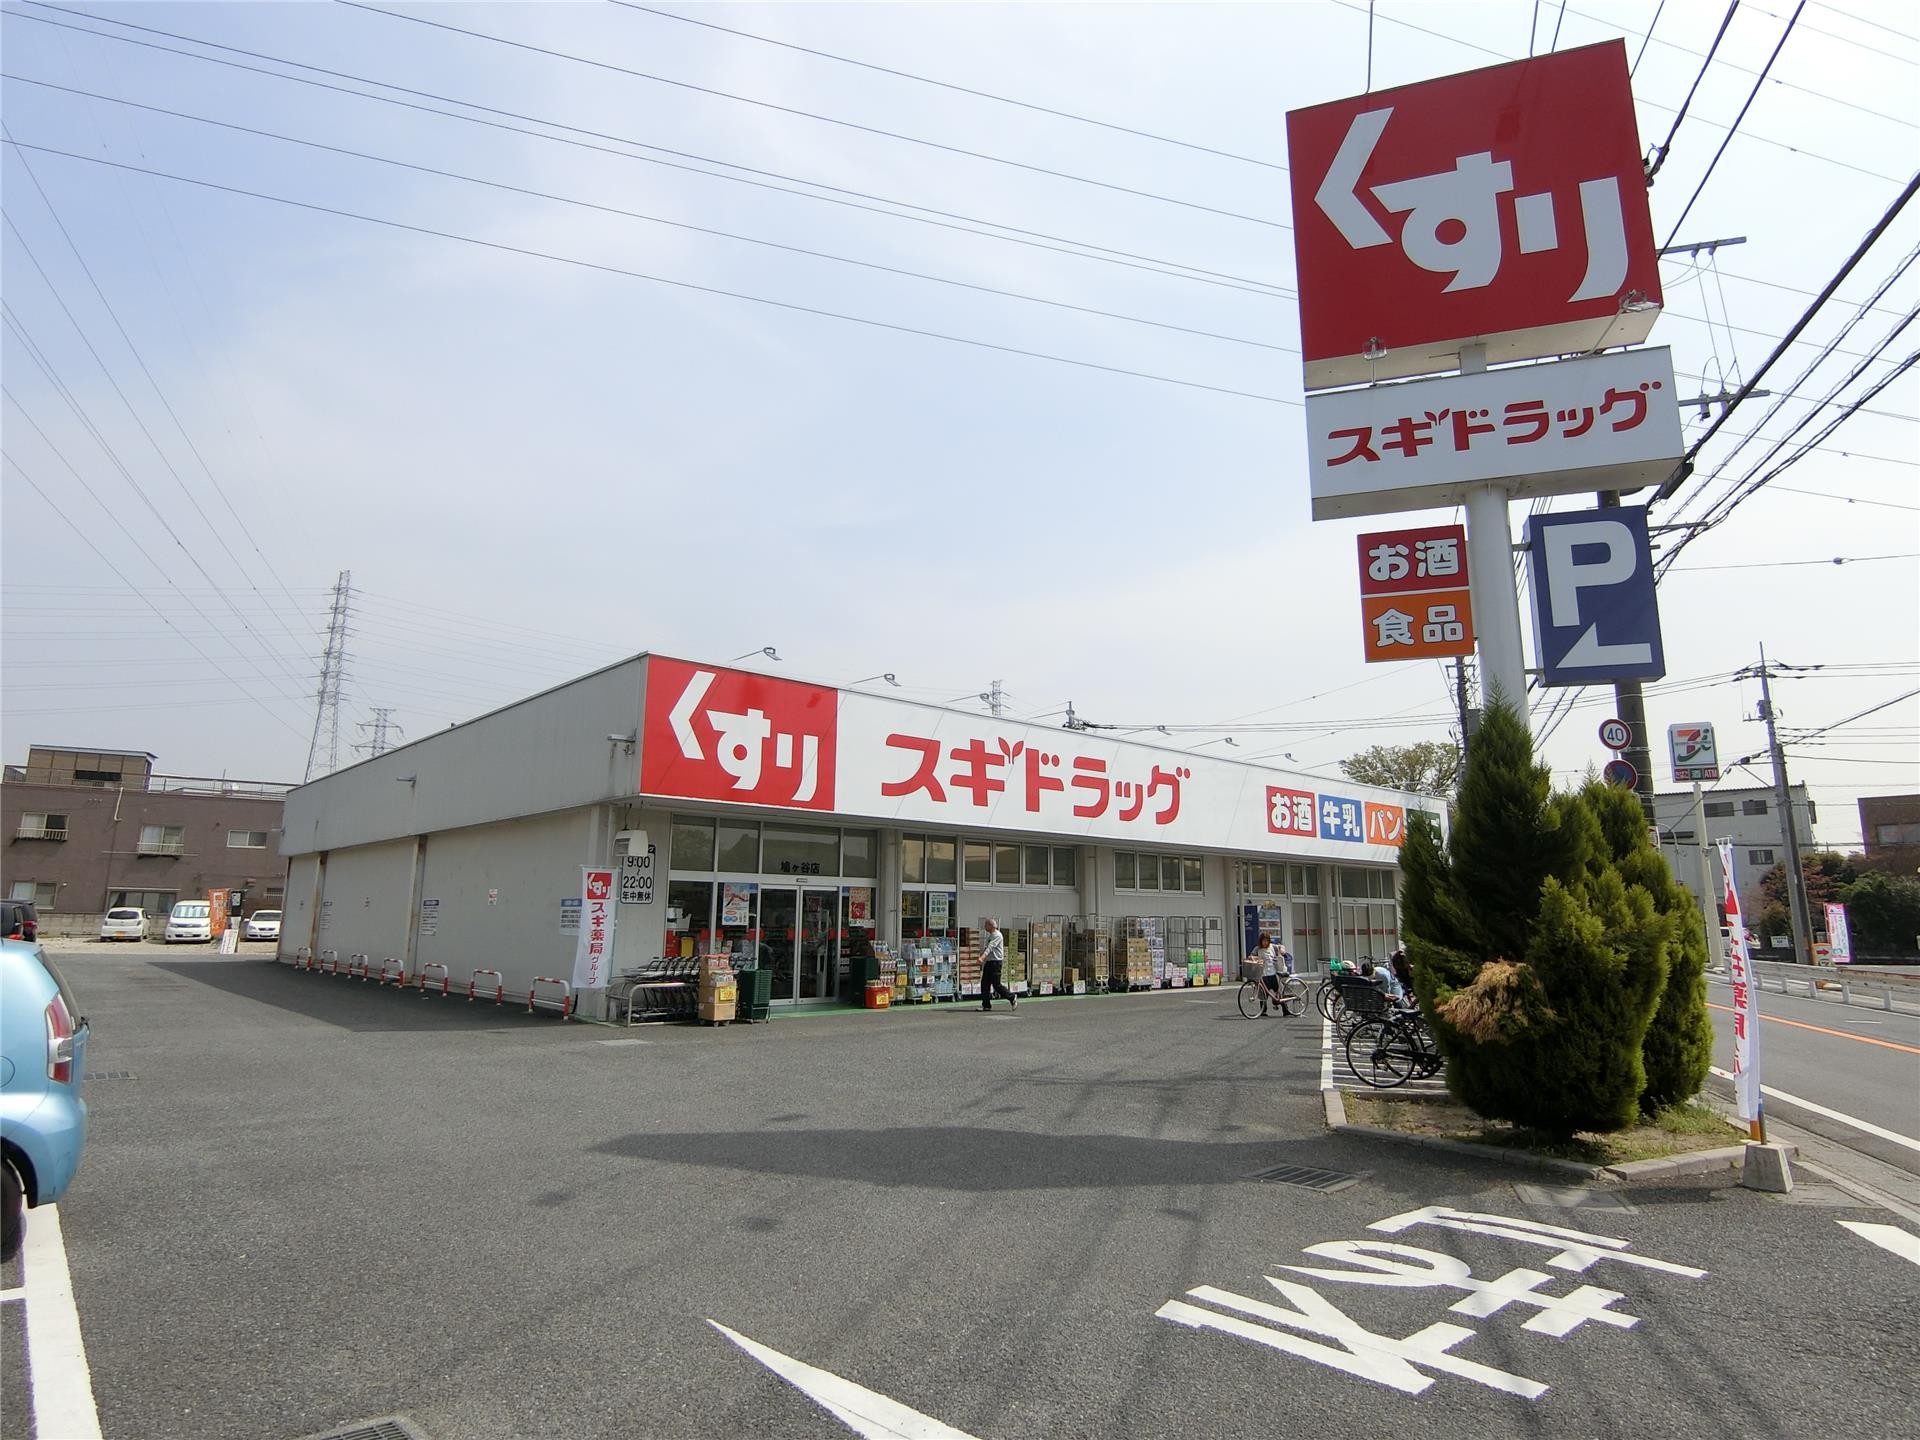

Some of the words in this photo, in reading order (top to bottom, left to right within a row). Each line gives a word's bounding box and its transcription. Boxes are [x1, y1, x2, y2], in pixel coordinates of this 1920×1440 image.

[1314, 105, 1629, 303] くすり
[1326, 380, 1663, 468] スギドラッグ
[1368, 537, 1460, 582] お酒
[1543, 520, 1638, 628] P
[1371, 604, 1464, 648] 食品
[668, 670, 820, 803] くすり
[1607, 727, 1625, 742] 40
[881, 733, 1191, 825] スギドラッグ
[1704, 768, 1717, 779] ATM
[1271, 792, 1313, 832] お酒
[1322, 800, 1360, 838] 牛乳
[1369, 808, 1401, 841] パン
[623, 876, 652, 889] 22:00
[627, 855, 650, 868] 9:00
[622, 890, 652, 901] 年中無休
[1154, 1205, 1711, 1399] 止まれ
